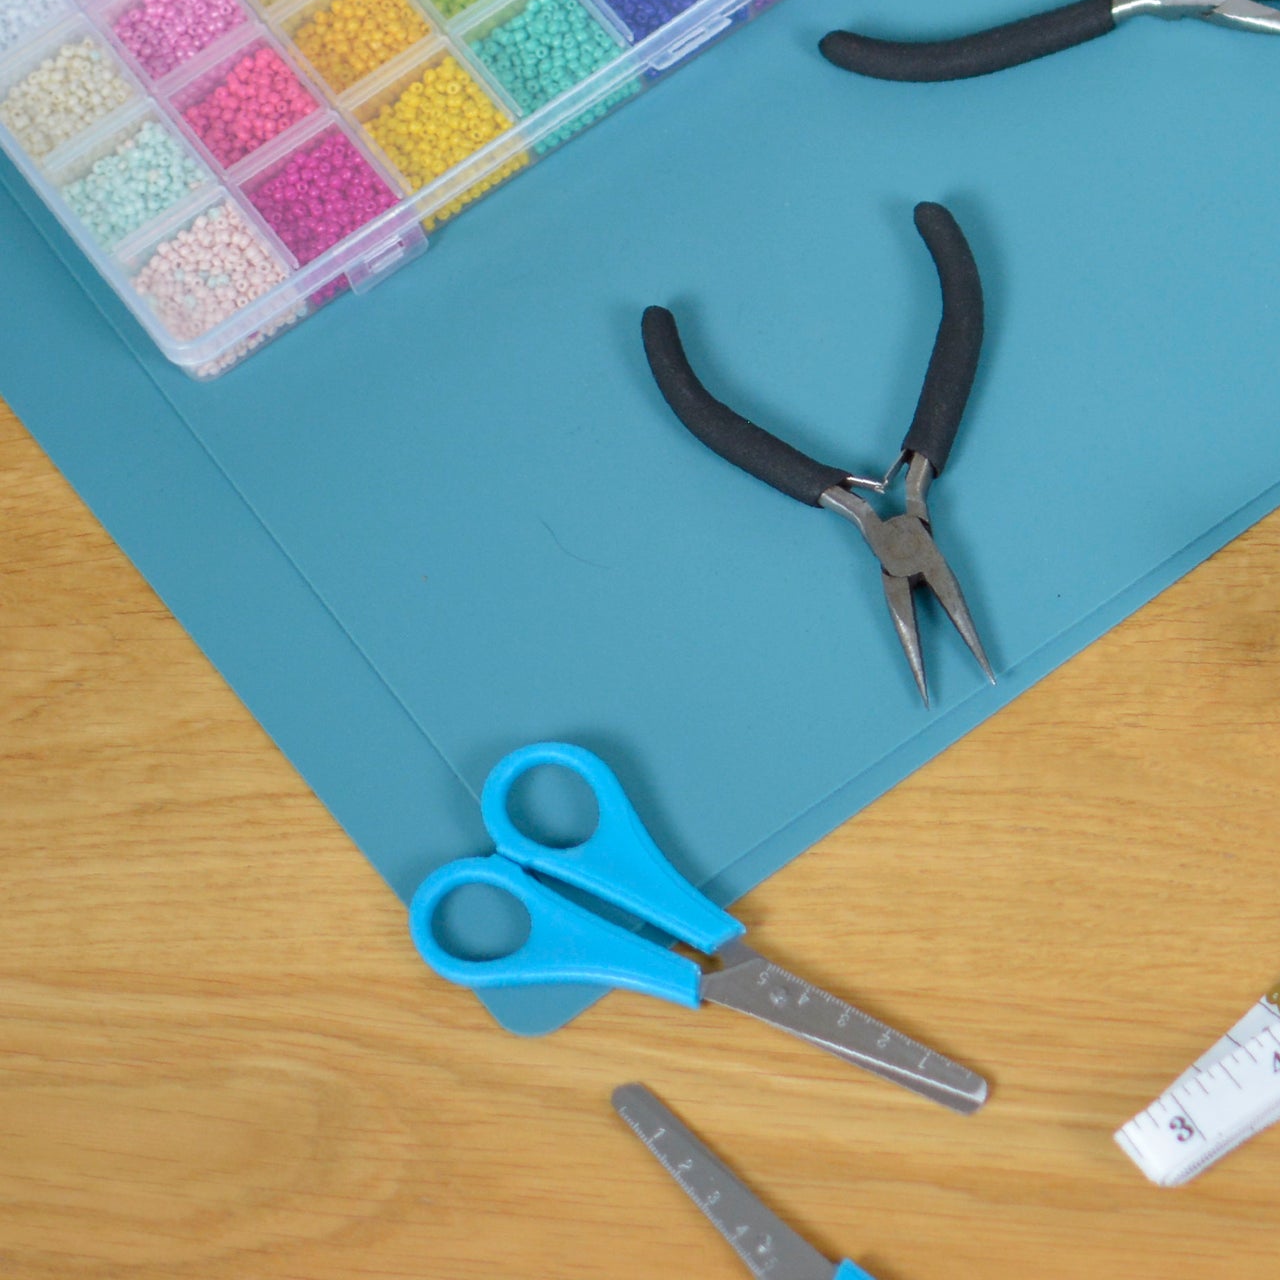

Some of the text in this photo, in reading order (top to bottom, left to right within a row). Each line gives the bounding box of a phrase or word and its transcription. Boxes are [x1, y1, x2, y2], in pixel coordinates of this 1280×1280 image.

[757, 971, 929, 1070] 1 2 3 4 5
[1169, 1116, 1195, 1142] 3
[653, 1127, 667, 1140] 1
[677, 1158, 693, 1170] 2
[707, 1190, 721, 1205] 3
[735, 1224, 750, 1237] 4
